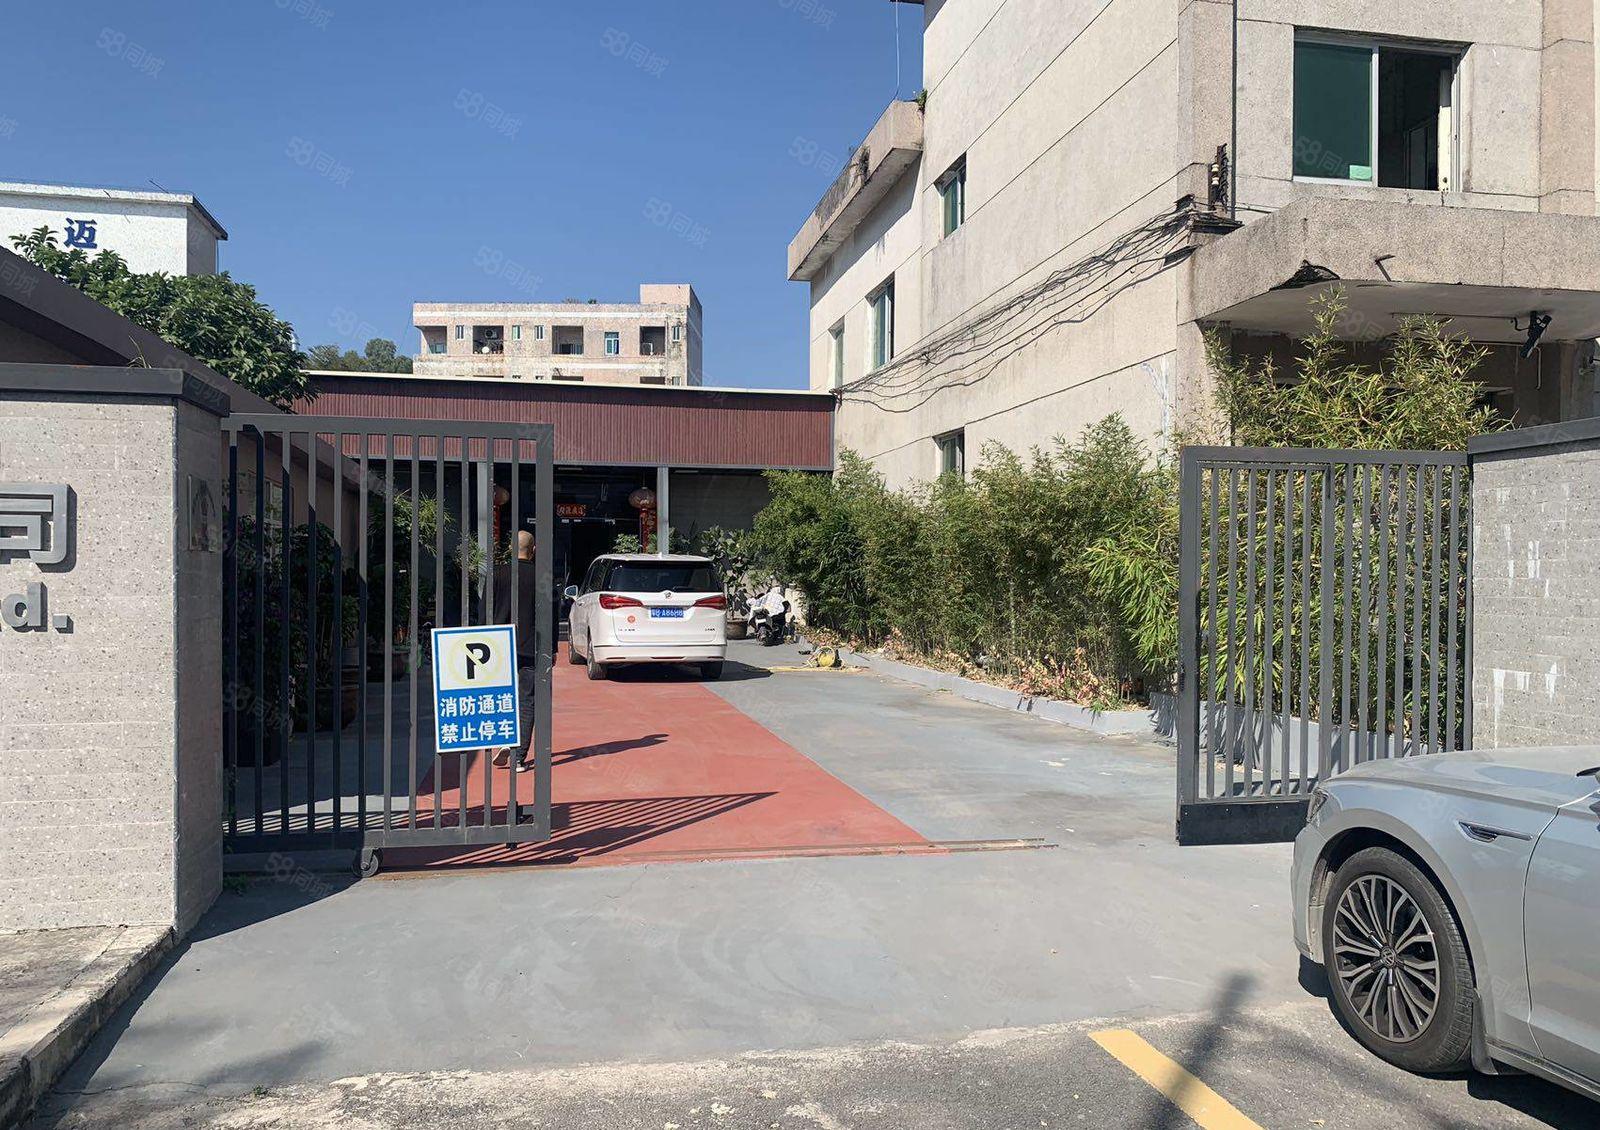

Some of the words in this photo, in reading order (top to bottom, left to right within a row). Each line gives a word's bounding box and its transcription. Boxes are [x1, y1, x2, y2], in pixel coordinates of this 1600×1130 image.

[63, 217, 98, 249] 迈
[440, 693, 514, 717] 消防通道
[441, 719, 515, 744] 禁止停车
